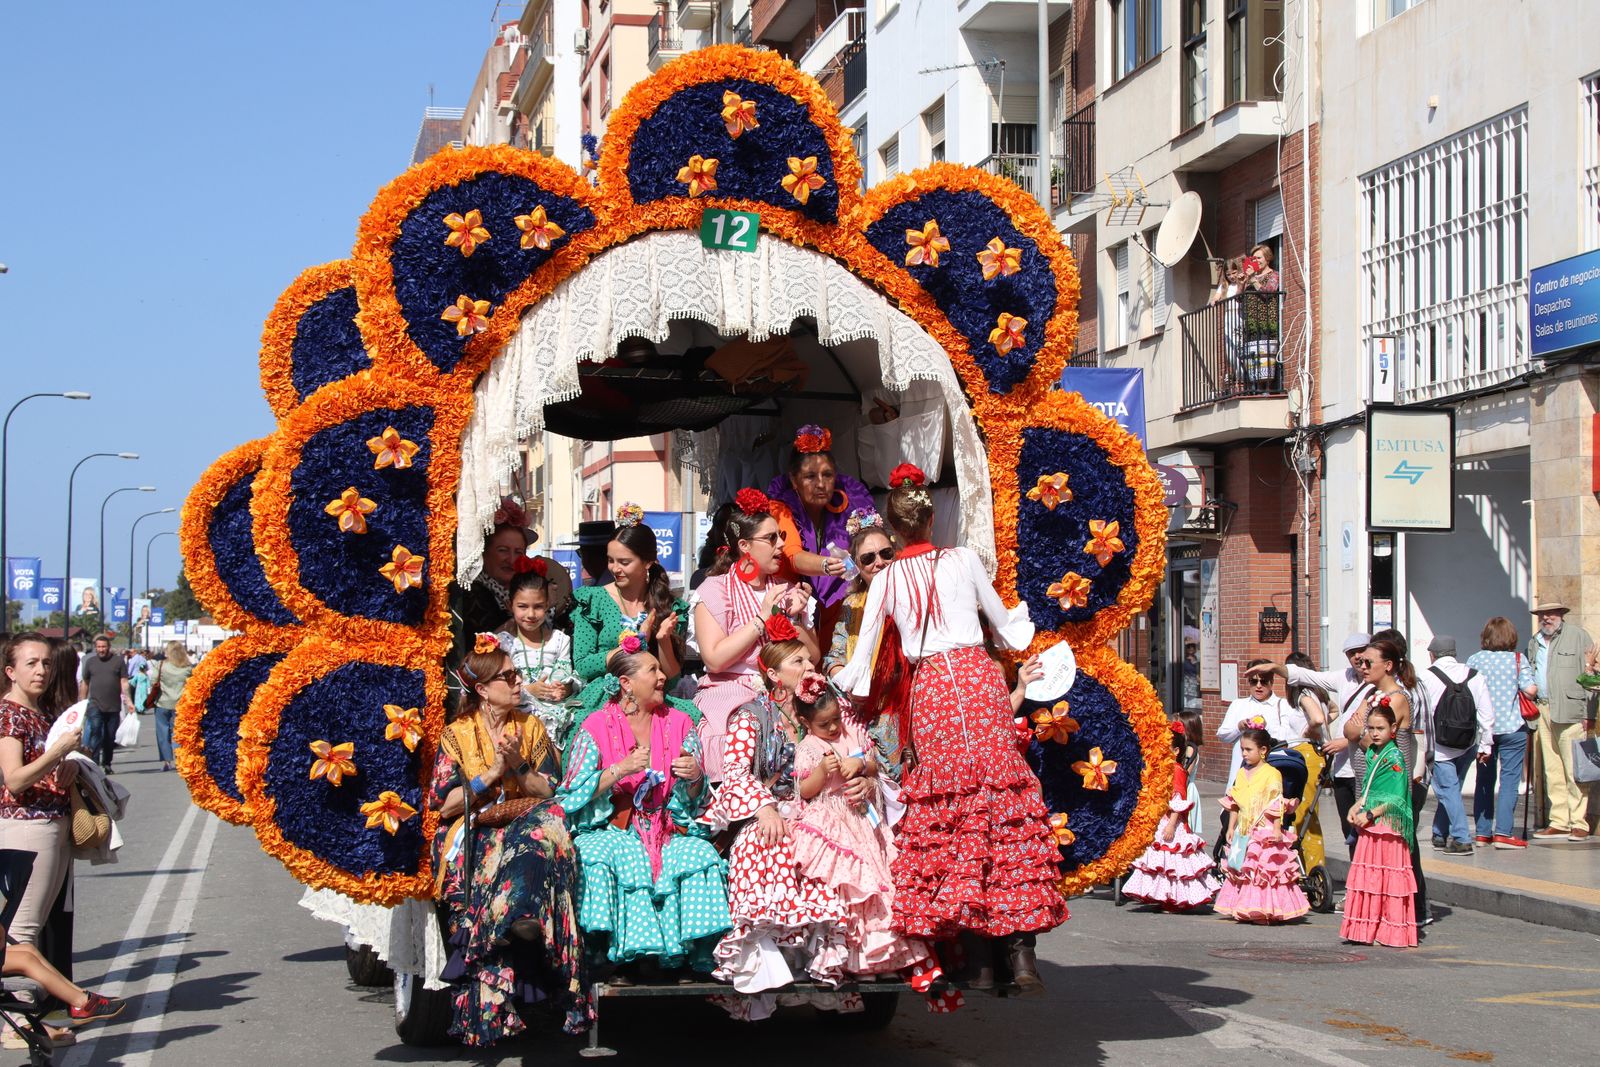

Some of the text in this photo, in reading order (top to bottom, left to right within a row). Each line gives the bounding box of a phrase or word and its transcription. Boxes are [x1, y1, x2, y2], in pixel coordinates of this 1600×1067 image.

[712, 214, 750, 248] 12
[1535, 279, 1558, 295] Centro
[1560, 275, 1569, 288] de
[1535, 298, 1571, 316] Despachos
[1535, 313, 1598, 338] Salas de reuniones
[1379, 338, 1387, 353] 1
[1379, 354, 1389, 368] 5
[1380, 369, 1388, 385] 7
[1088, 401, 1129, 417] OTA
[1376, 439, 1445, 453] EMTUSA
[652, 528, 674, 537] OTA
[14, 568, 34, 576] VOTA
